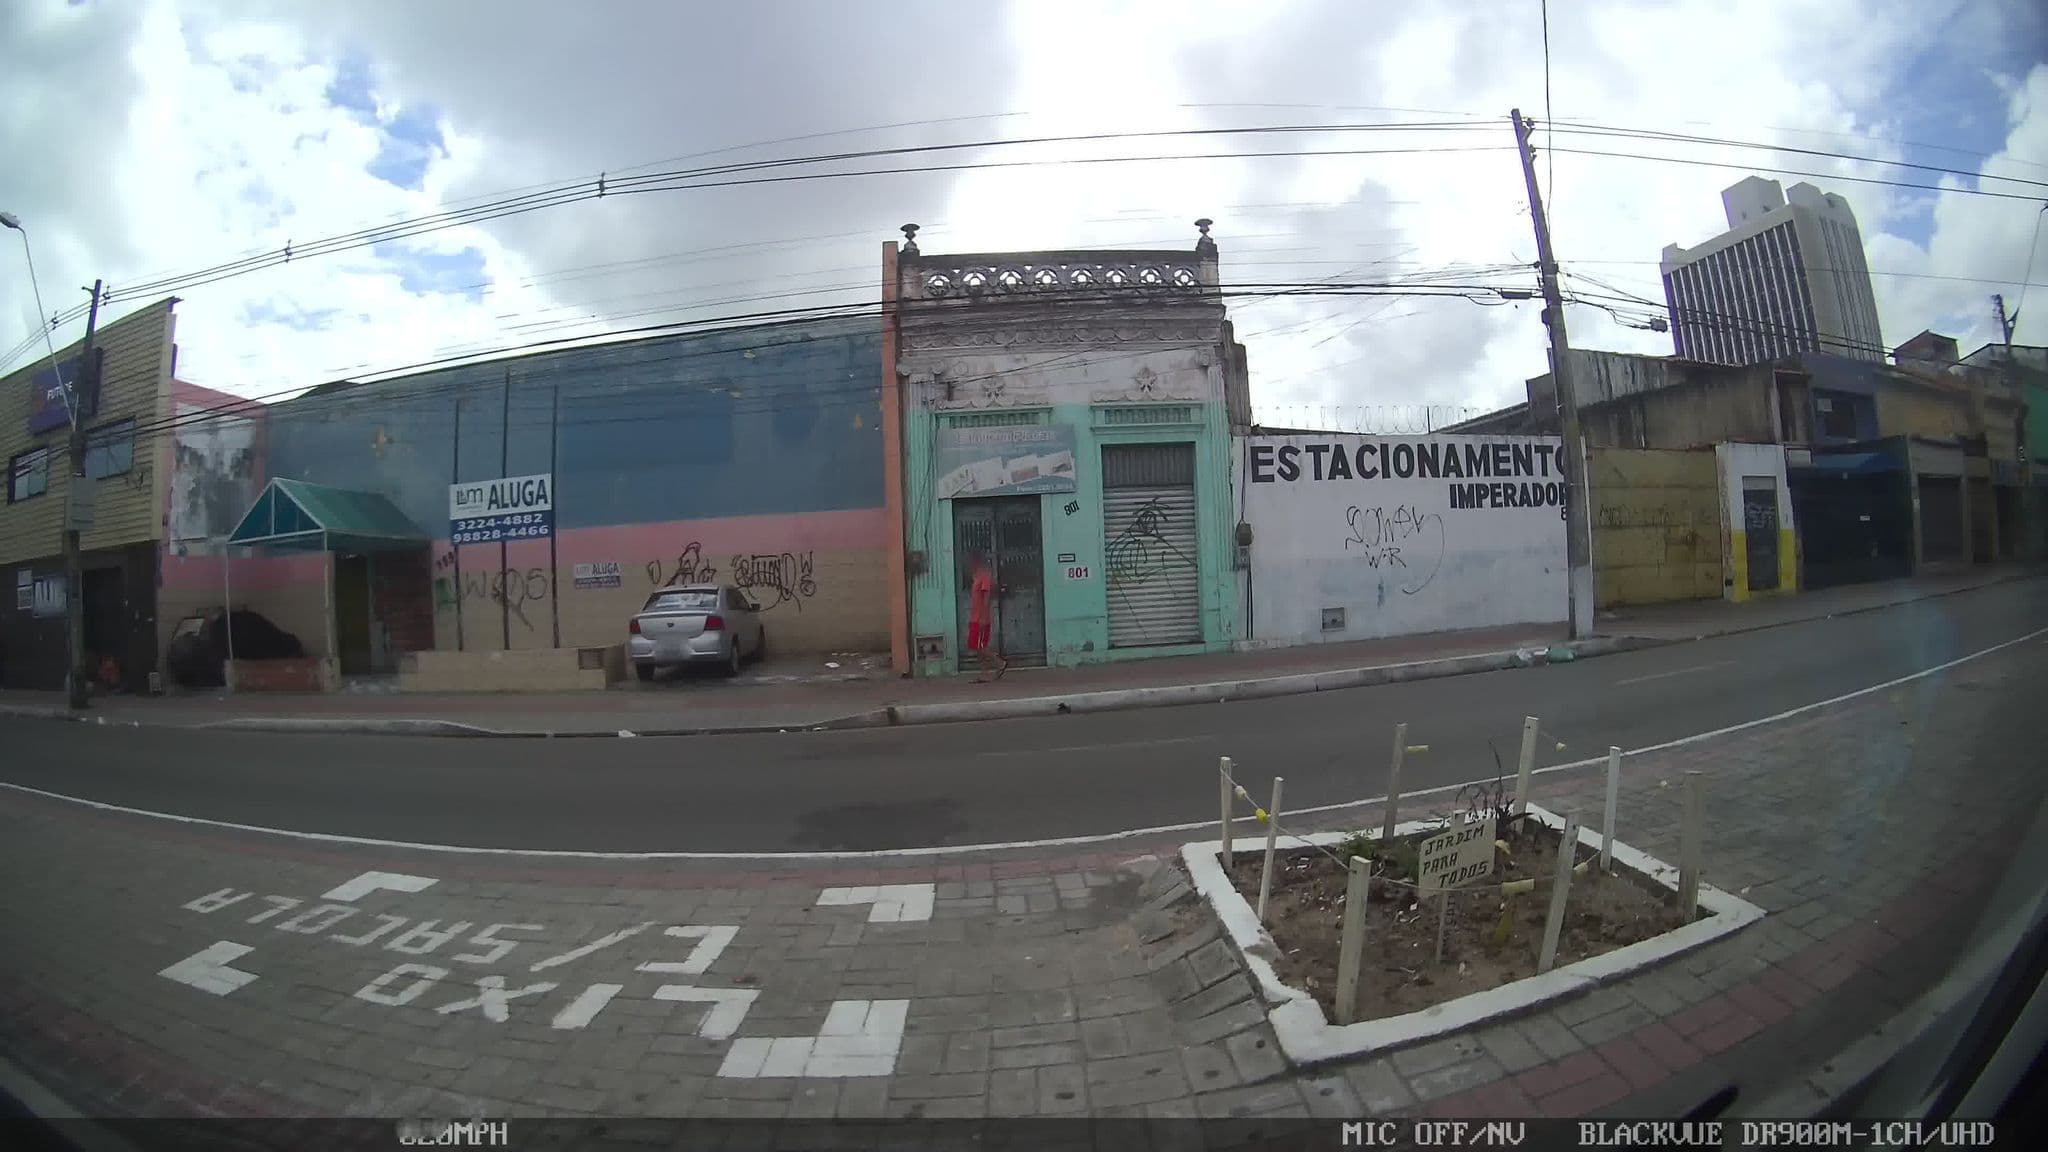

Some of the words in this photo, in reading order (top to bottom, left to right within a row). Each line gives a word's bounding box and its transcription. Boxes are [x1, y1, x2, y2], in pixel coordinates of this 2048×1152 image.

[487, 479, 548, 510] ALUGA
[1064, 500, 1080, 516] 801
[457, 513, 543, 530] 3224-4882
[453, 525, 549, 542] 98828-4466
[592, 562, 619, 575] ALUGA
[1068, 567, 1088, 578] 801
[1425, 824, 1484, 856] JARDIM
[1423, 851, 1458, 875] PARA
[1439, 861, 1489, 888] TODOS
[354, 964, 761, 1039] LIXO
